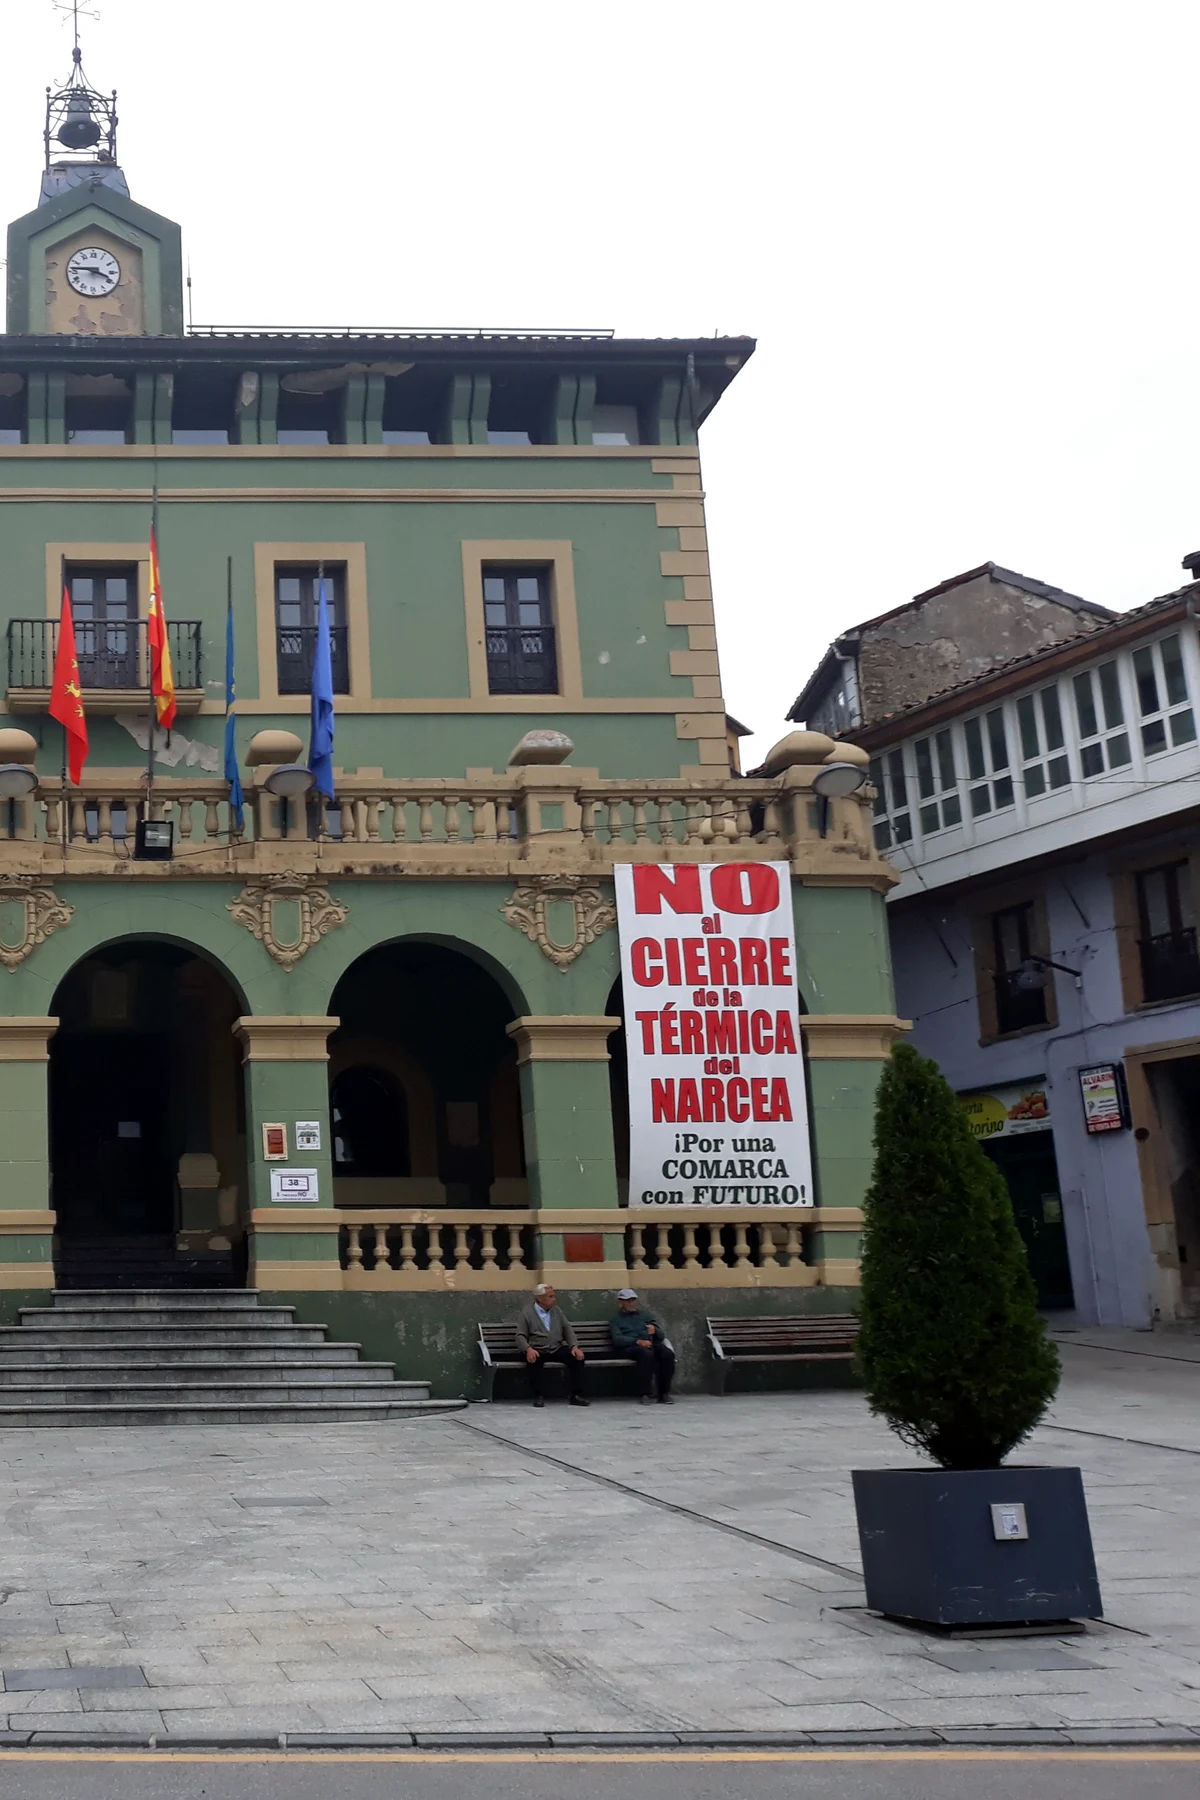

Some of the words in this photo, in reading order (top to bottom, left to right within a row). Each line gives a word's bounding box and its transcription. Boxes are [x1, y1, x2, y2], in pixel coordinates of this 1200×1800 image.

[632, 862, 779, 915] NO
[701, 913, 722, 934] al
[631, 937, 792, 987] CIERRE
[692, 988, 719, 1006] de
[722, 988, 742, 1006] la
[635, 1001, 797, 1055] TÉRMICA
[703, 1056, 740, 1075] del
[651, 1077, 793, 1123] NARCEA
[969, 1117, 1004, 1134] torino
[675, 1134, 724, 1154] ¡Por
[732, 1138, 775, 1153] una
[662, 1159, 789, 1179] COMARCA
[642, 1190, 684, 1204] con
[692, 1185, 806, 1205] FUTURO!
